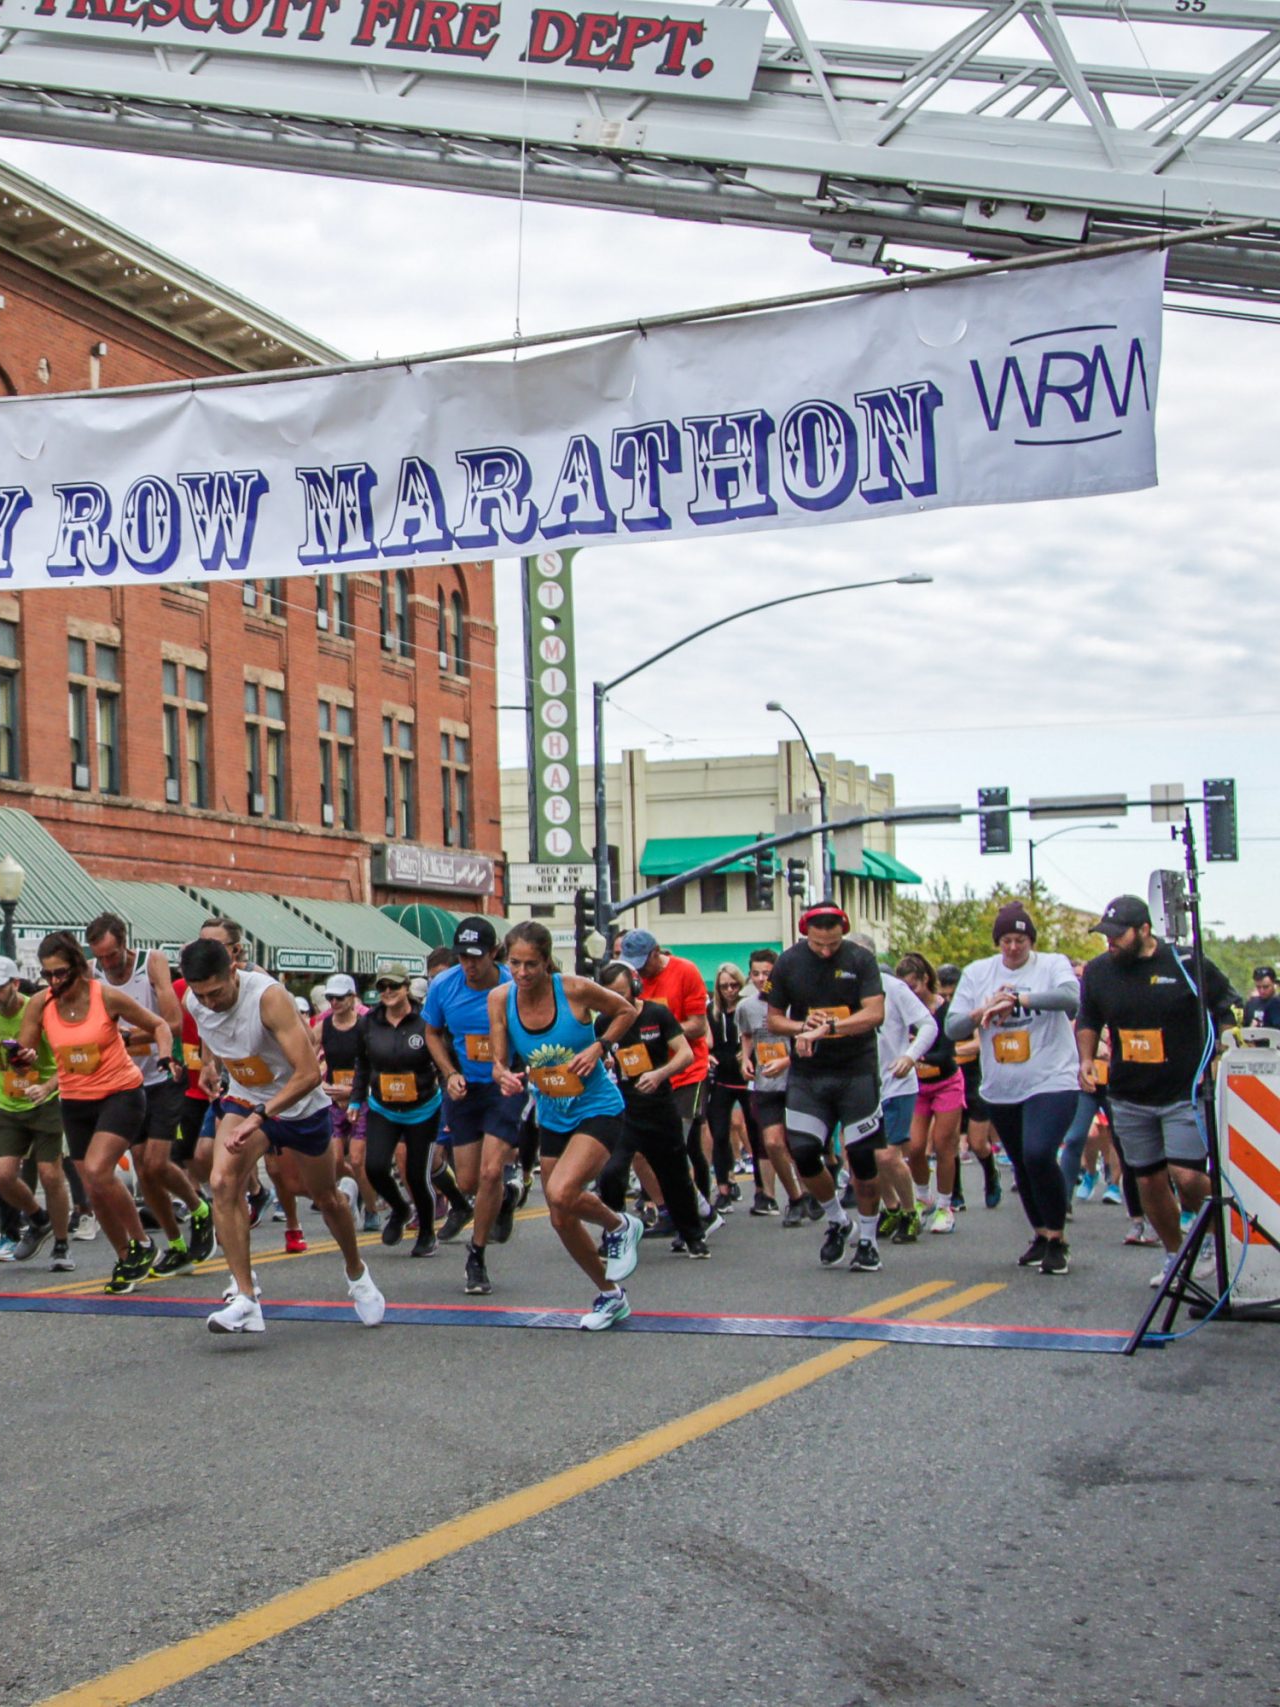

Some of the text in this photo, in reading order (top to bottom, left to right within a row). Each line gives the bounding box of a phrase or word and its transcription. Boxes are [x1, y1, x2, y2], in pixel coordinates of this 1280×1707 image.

[351, 0, 501, 61] FIRE
[519, 9, 714, 79] DEPT.
[969, 337, 1151, 432] WRM
[45, 468, 270, 580] ROW
[295, 379, 944, 567] MARATHON
[542, 637, 566, 854] MICHAEL
[535, 866, 584, 874] CHECK OUT
